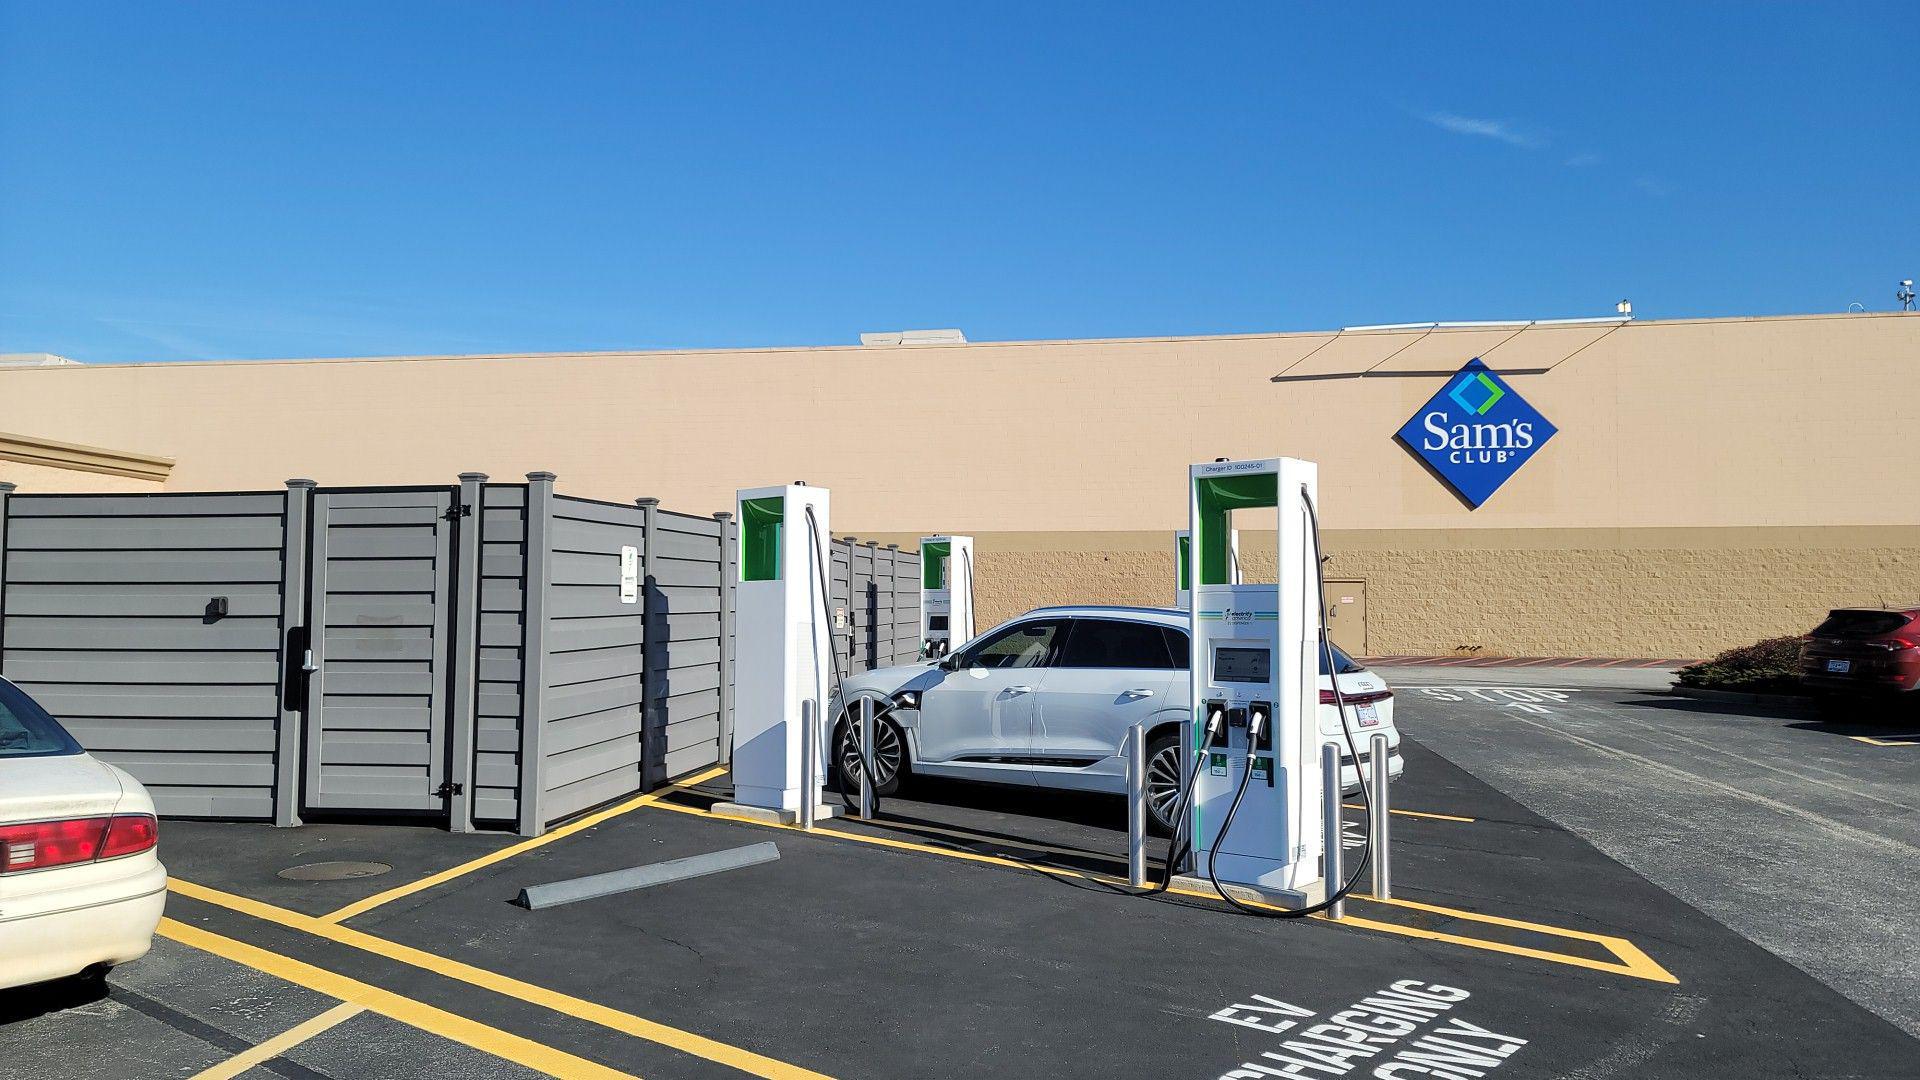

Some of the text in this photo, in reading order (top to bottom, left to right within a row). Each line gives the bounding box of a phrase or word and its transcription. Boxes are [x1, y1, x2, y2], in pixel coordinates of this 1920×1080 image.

[1424, 412, 1533, 450] Sam's
[1205, 465, 1226, 473] Charger
[1420, 688, 1570, 703] STOP
[1207, 994, 1318, 1034] EV
